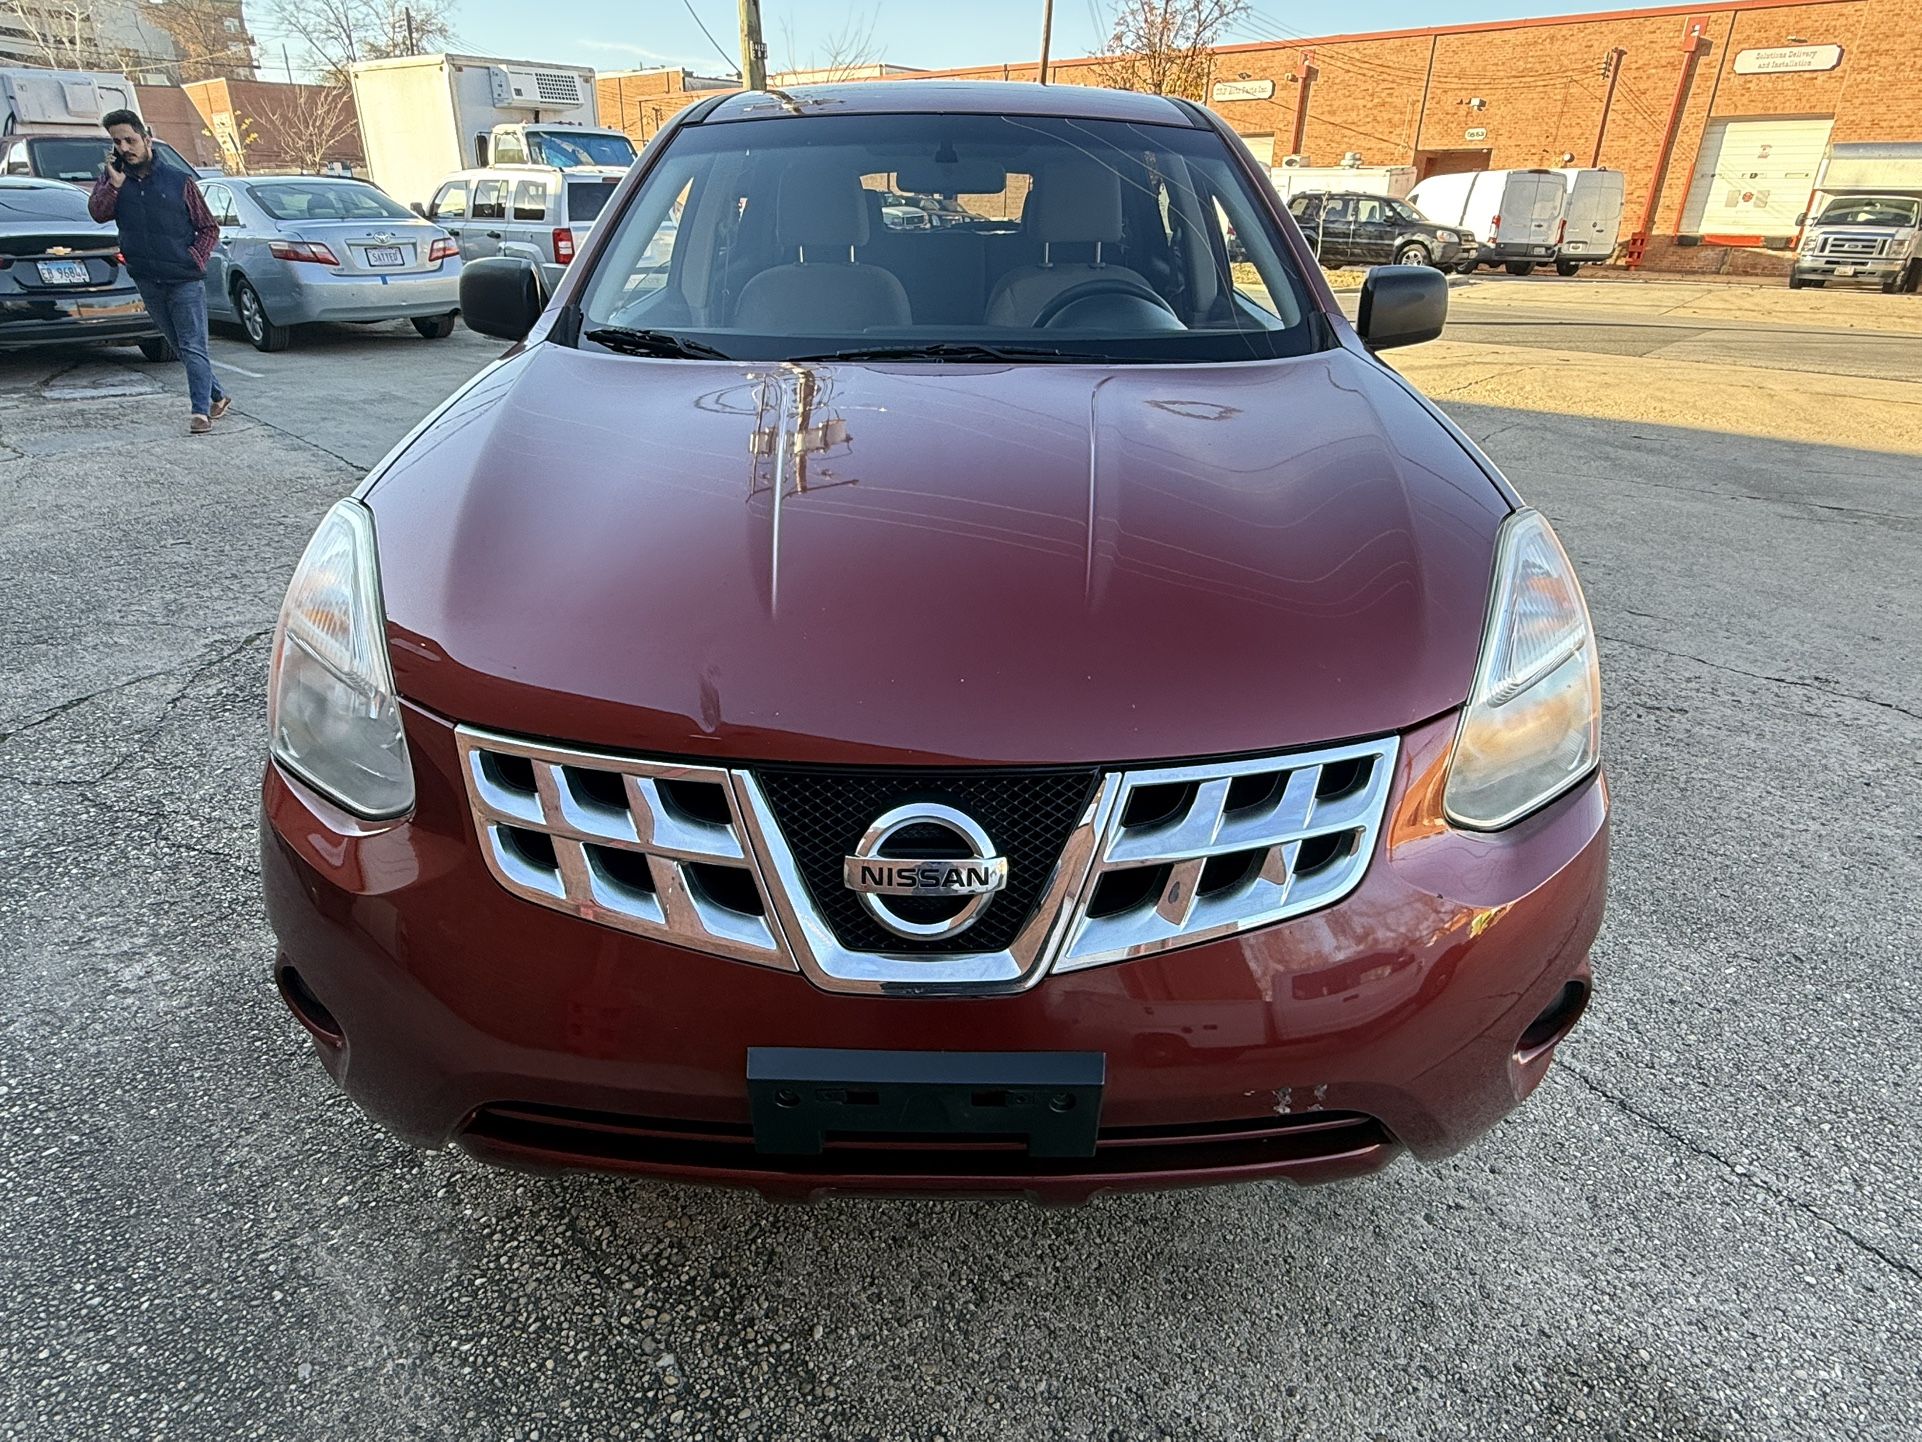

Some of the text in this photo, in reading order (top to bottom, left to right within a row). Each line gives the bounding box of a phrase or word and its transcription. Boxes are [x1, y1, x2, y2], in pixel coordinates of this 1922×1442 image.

[1788, 50, 1817, 59] Delivery
[1757, 60, 1812, 69] and Installation
[860, 865, 989, 888] NISSAN
